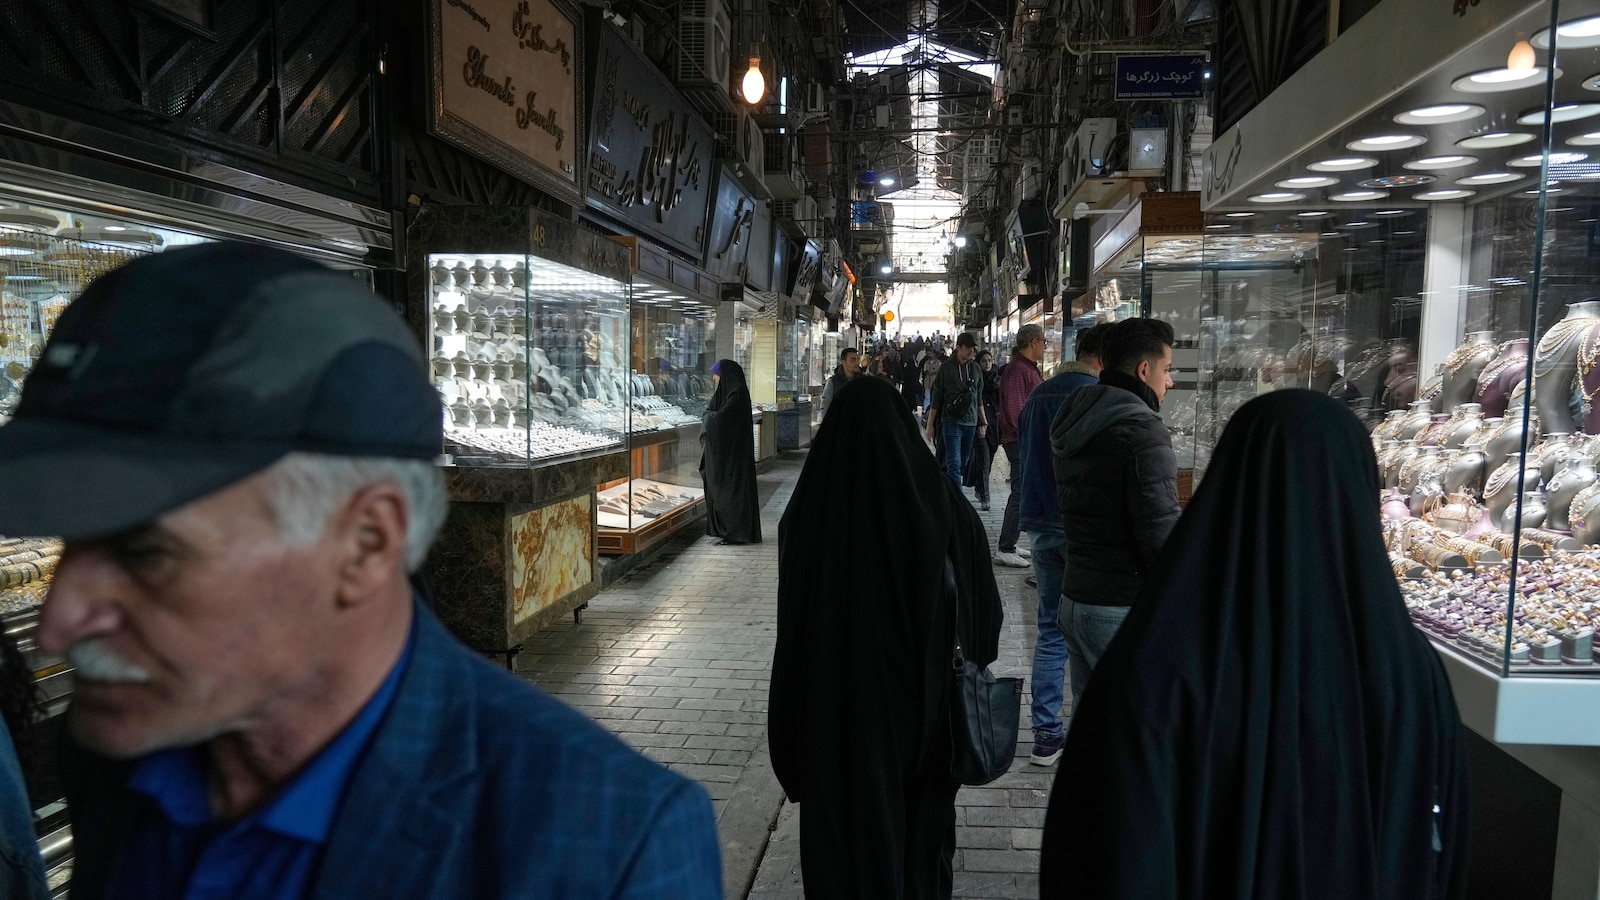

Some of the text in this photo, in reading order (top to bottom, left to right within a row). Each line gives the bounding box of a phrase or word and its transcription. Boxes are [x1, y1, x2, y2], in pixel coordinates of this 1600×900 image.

[1126, 70, 1195, 84] کوچک زرگرها
[533, 224, 546, 248] 48
